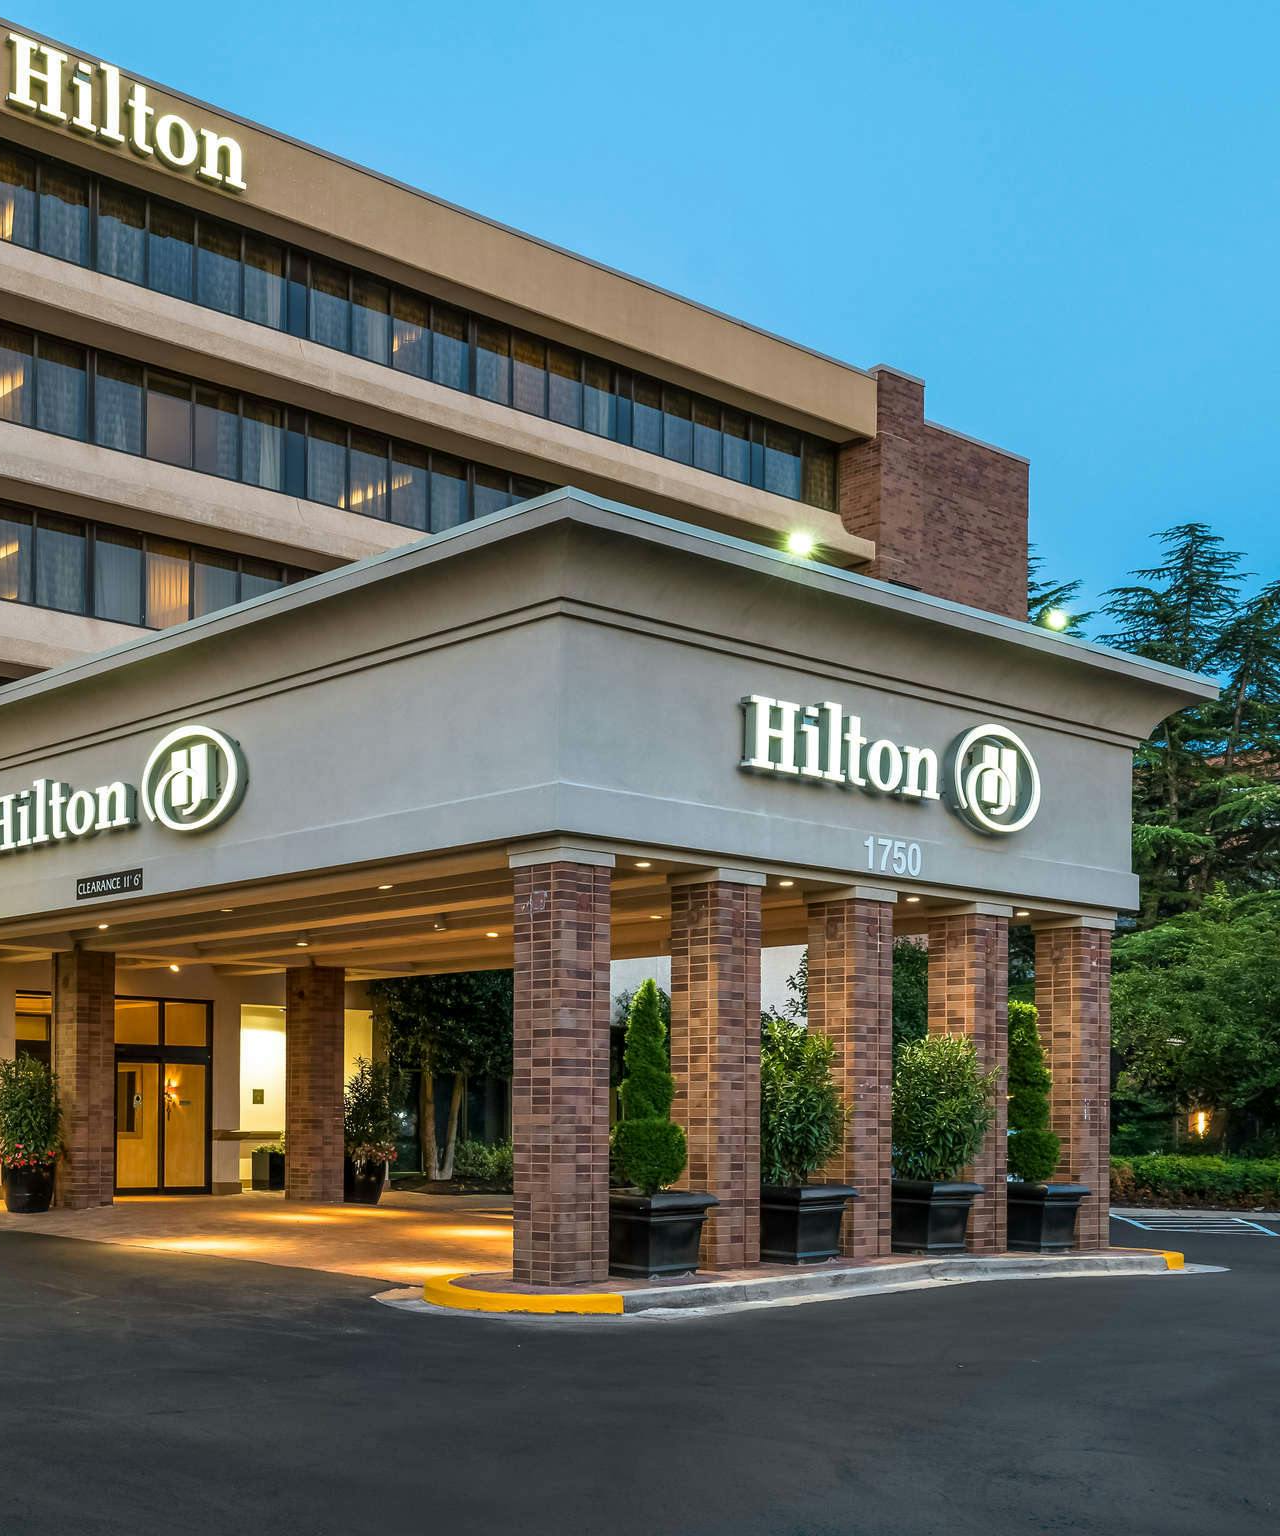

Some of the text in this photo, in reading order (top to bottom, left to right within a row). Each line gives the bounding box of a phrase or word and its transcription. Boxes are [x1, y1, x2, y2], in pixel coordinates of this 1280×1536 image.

[6, 32, 247, 191] Hilton
[739, 694, 941, 800] Hilton
[77, 877, 121, 895] CLEARANCE
[863, 835, 921, 877] 1750
